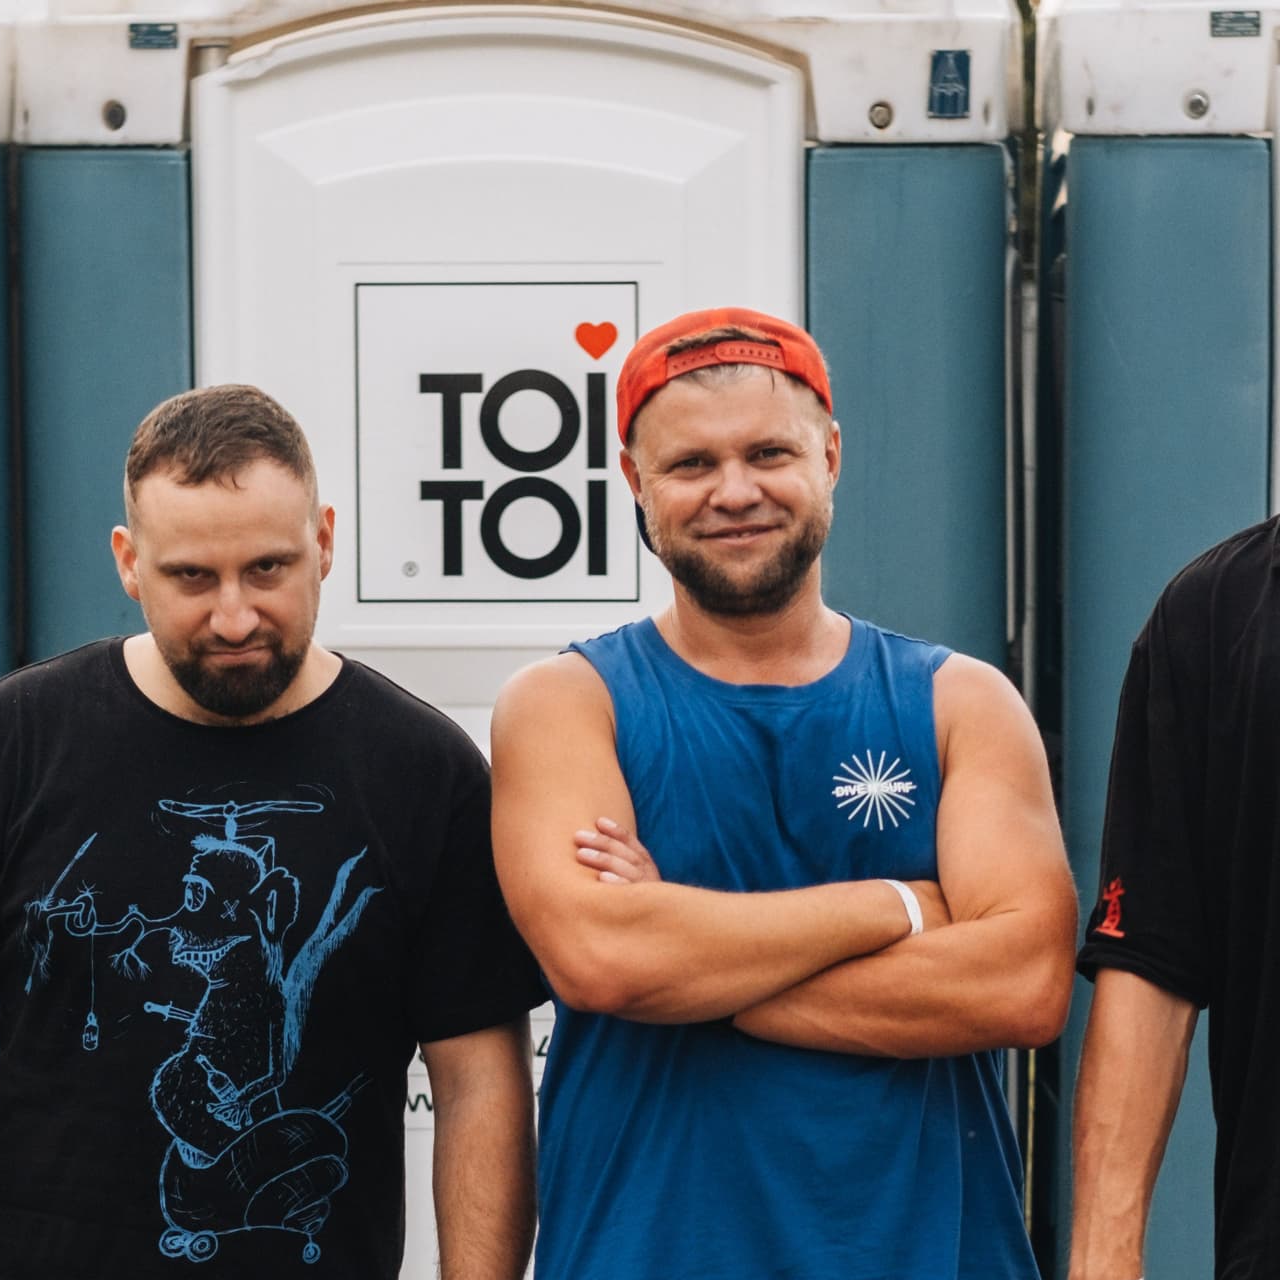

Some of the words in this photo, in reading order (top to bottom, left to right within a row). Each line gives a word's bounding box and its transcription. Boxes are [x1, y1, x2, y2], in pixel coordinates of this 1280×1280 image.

[419, 369, 607, 473] TOI
[420, 476, 608, 580] TOI
[835, 785, 867, 798] DIVE
[881, 782, 913, 793] SURF
